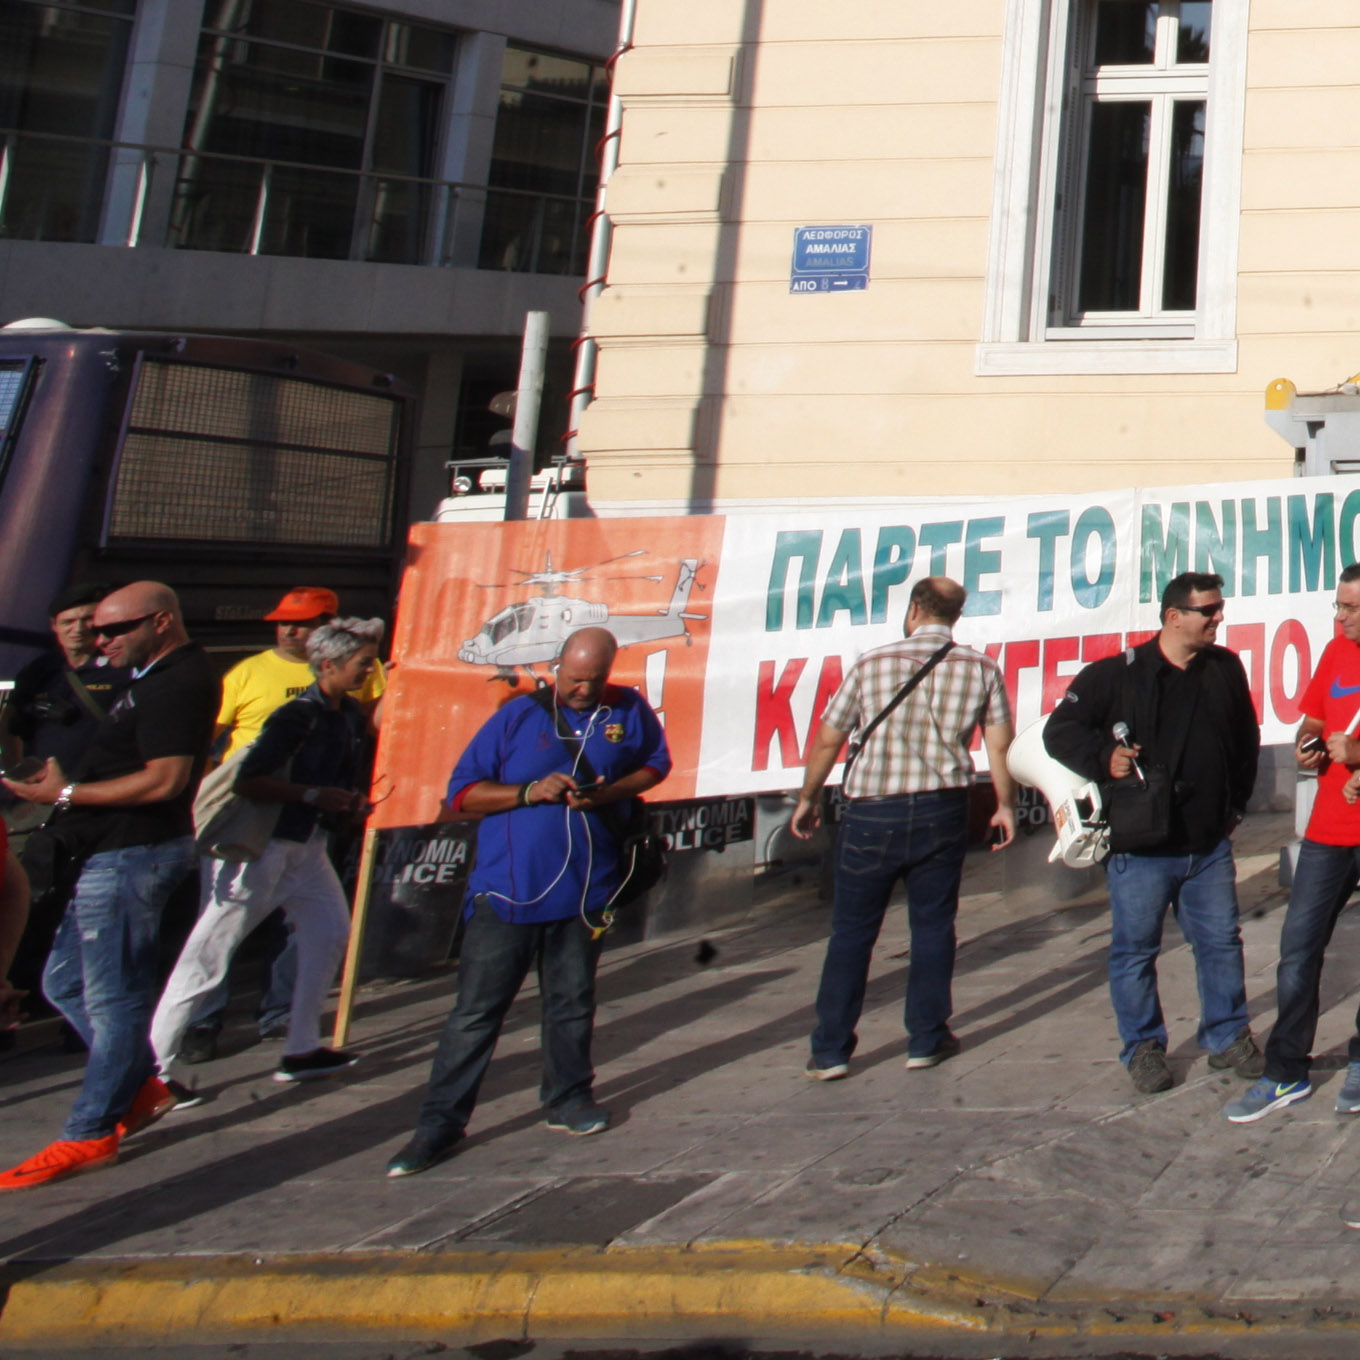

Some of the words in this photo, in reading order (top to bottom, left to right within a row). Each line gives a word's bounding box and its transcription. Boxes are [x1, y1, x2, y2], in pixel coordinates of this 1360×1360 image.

[802, 230, 863, 240] ΛΕΩΦΟΡΟΣ
[805, 243, 857, 254] ΑΜΑΛΙΑΣ
[793, 280, 817, 291] ΑΠΟ
[765, 516, 1006, 632] ΠΑΡΤΕ
[1026, 506, 1116, 611] ΤΟ
